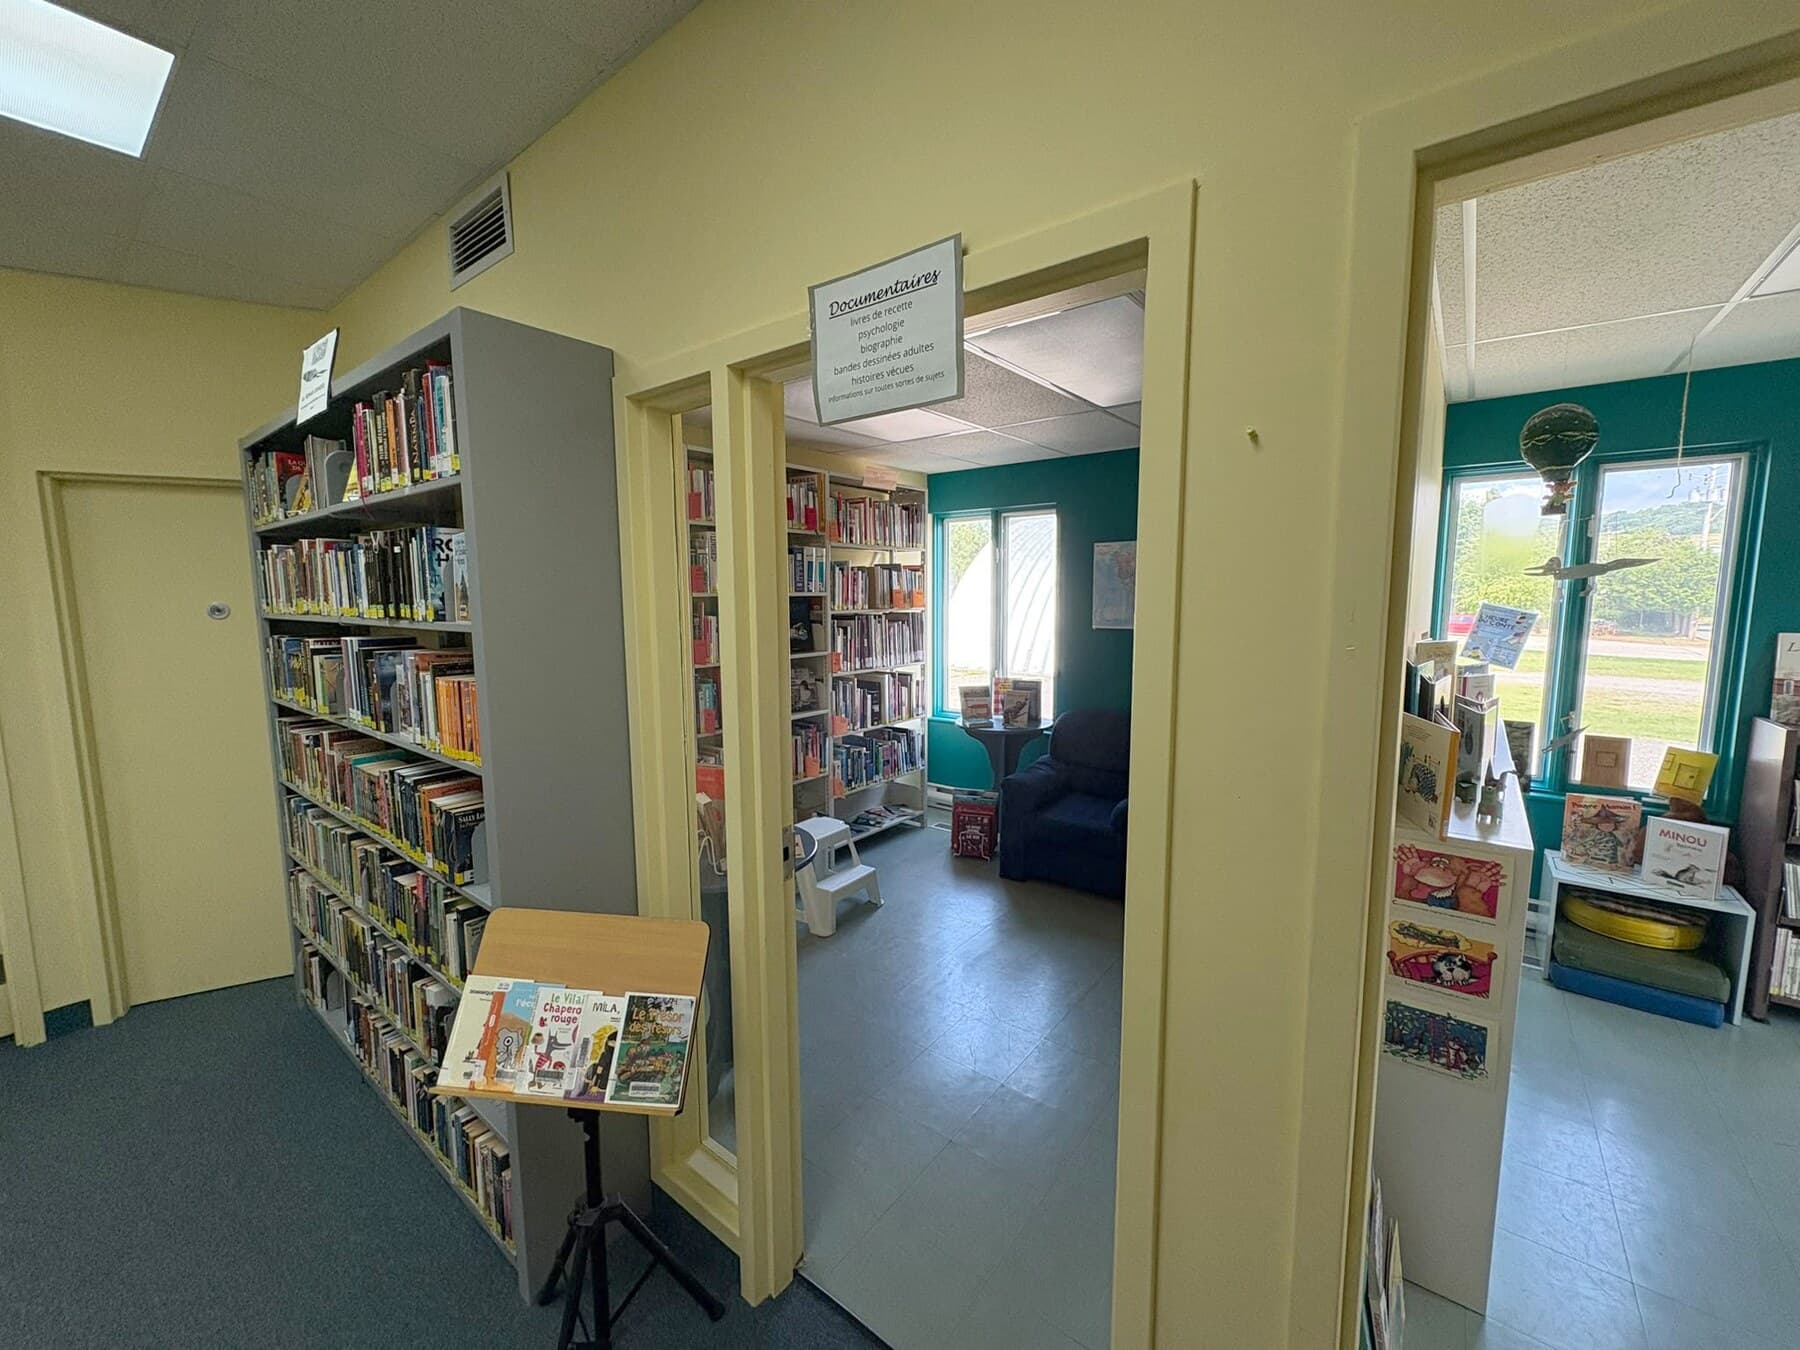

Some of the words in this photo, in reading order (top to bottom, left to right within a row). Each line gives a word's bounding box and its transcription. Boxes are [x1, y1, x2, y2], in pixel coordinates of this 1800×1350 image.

[829, 269, 941, 316] Documentaires
[851, 312, 871, 327] livres
[872, 308, 882, 321] de
[884, 300, 913, 317] recette
[858, 318, 905, 341] psychologie
[860, 335, 903, 355] biographie
[833, 362, 861, 376] bandes
[862, 350, 901, 369] dessinées
[903, 341, 935, 358] adultes
[851, 369, 884, 386] histoires
[886, 363, 915, 379] vécues
[864, 387, 874, 397] sur
[874, 383, 894, 394] toutes
[895, 378, 915, 389] sortes
[915, 375, 924, 385] de
[925, 370, 945, 383] sujets
[1659, 829, 1707, 848] MINOU
[543, 1002, 582, 1015] Chapero
[564, 993, 585, 1005] Vilai
[550, 1014, 578, 1026] rouge
